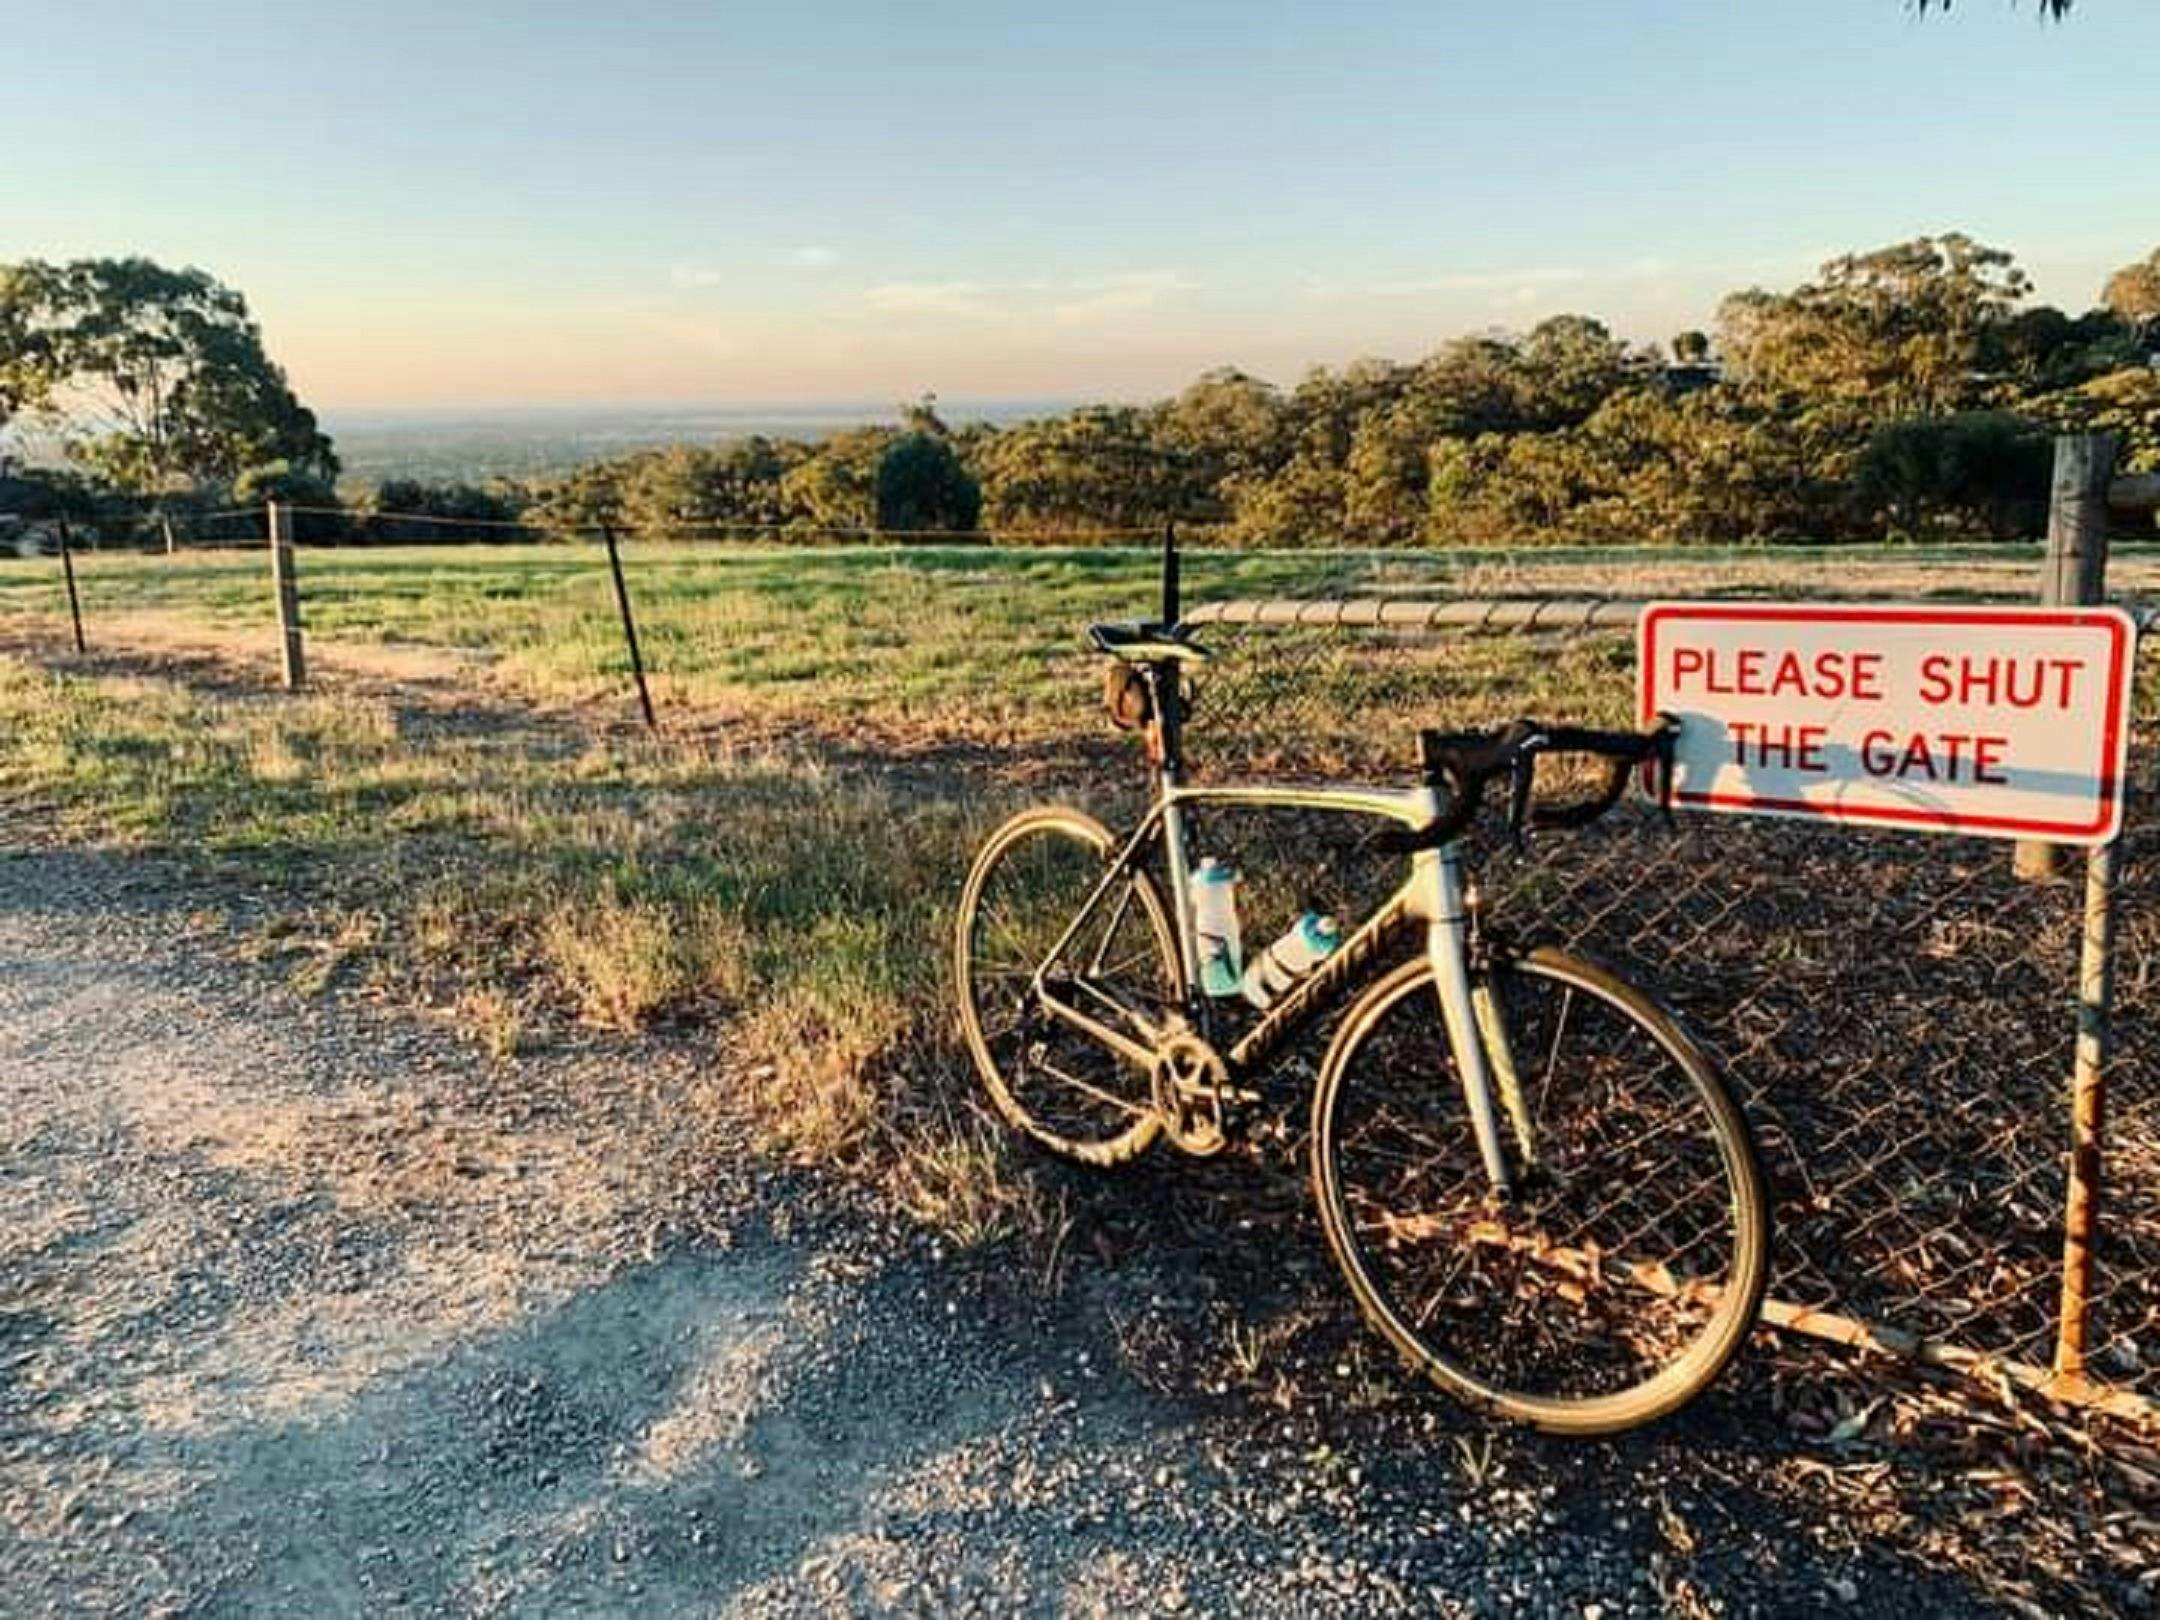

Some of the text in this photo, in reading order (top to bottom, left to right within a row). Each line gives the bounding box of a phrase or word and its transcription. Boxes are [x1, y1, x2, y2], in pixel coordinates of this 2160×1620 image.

[1672, 649, 2084, 709] PLEASE SHUT
[1728, 722, 2009, 784] THE GATE
